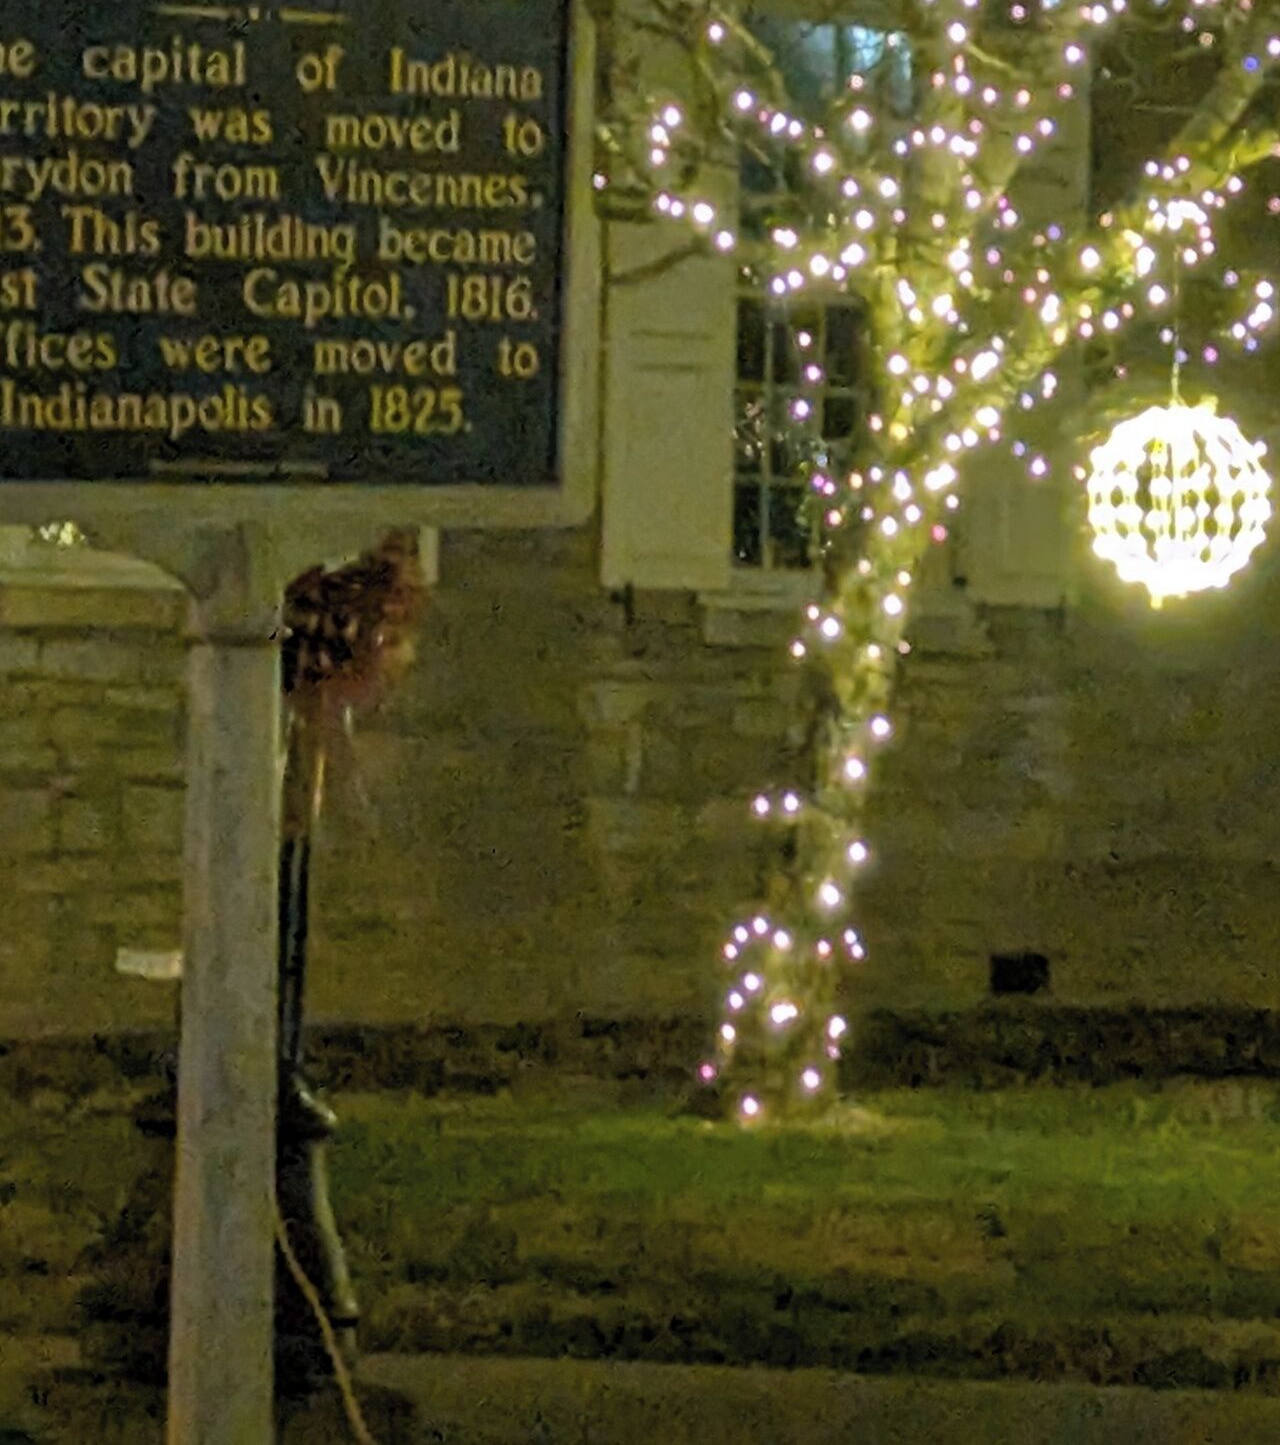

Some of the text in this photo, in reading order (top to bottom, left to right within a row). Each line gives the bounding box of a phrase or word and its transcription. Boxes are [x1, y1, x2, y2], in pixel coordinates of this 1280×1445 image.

[82, 34, 246, 93] capital
[297, 44, 344, 92] of
[390, 46, 542, 99] Indiana
[189, 106, 271, 145] was
[326, 109, 460, 153] moved
[503, 111, 542, 154] to
[174, 152, 279, 202] from
[62, 205, 160, 254] This
[184, 209, 357, 272] building
[377, 216, 537, 264] became
[80, 263, 198, 314] State
[448, 274, 539, 320] 1816.
[160, 333, 271, 373] were
[314, 329, 456, 376] moved
[497, 337, 540, 377] to
[0, 377, 473, 439] Indianapolis in 1825.
